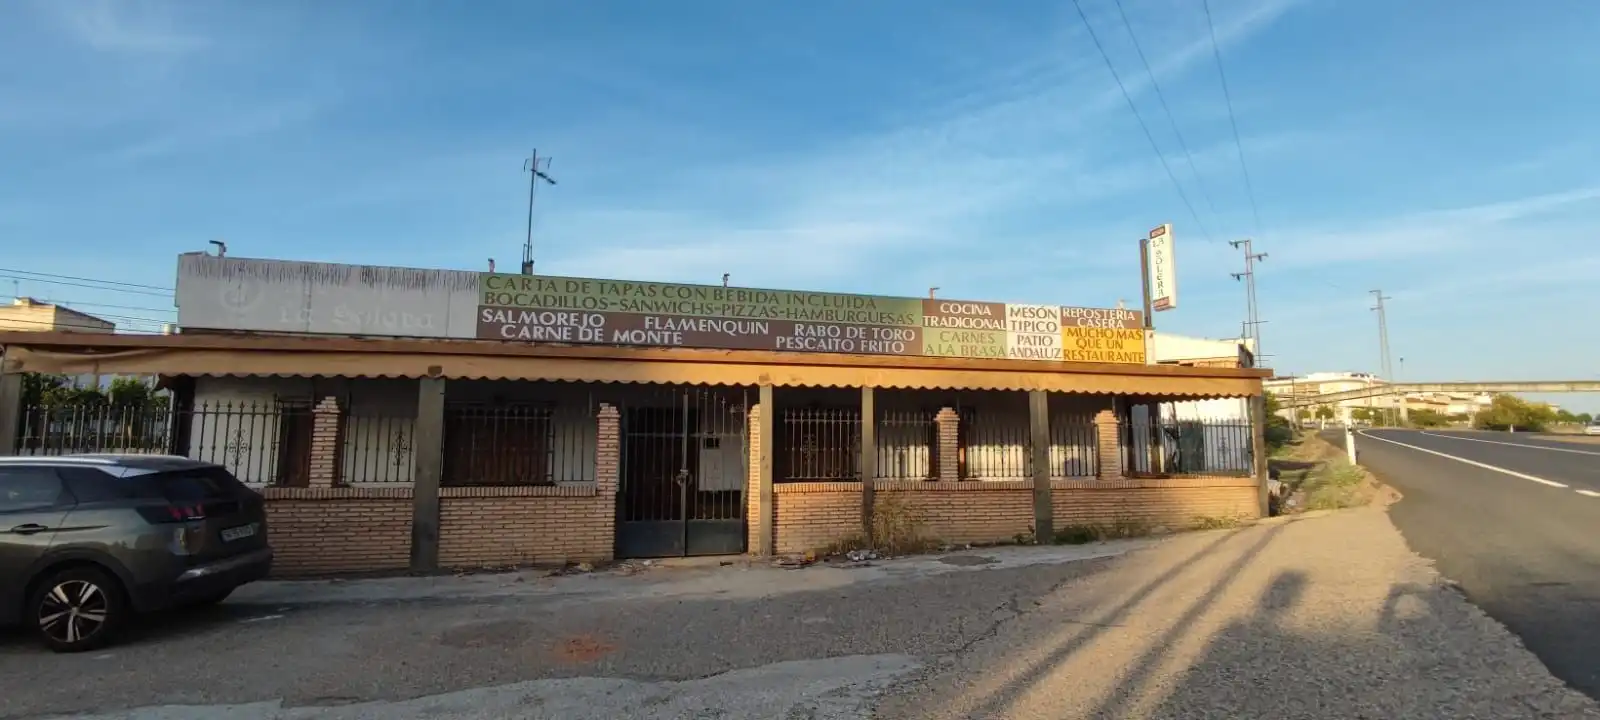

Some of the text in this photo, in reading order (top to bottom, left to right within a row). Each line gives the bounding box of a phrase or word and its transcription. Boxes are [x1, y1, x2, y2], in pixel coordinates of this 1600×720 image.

[1155, 250, 1165, 297] SOLERA
[486, 275, 877, 310] CARTA DE TAPAS CON BEBIDA INCLUIDA
[940, 302, 991, 316] COCINA
[482, 308, 606, 329] SALMOREJO
[644, 316, 769, 336] FLAMENQUIN
[922, 315, 1006, 330] TRADICIONAL
[1077, 318, 1125, 329] CASERA
[501, 324, 682, 345] CARNE DE MONTE
[794, 323, 915, 342] RABO DE TORO
[940, 331, 996, 344] CARNES
[1067, 327, 1114, 339] MUCHO
[776, 336, 905, 353] PESCAITO FRITO
[1016, 334, 1053, 347] PATIO
[1075, 338, 1124, 350] QUE UN
[925, 344, 1006, 357] A LA BRASA
[1009, 346, 1062, 359] ANDALUZ
[1063, 348, 1145, 363] RESTAURANTE
